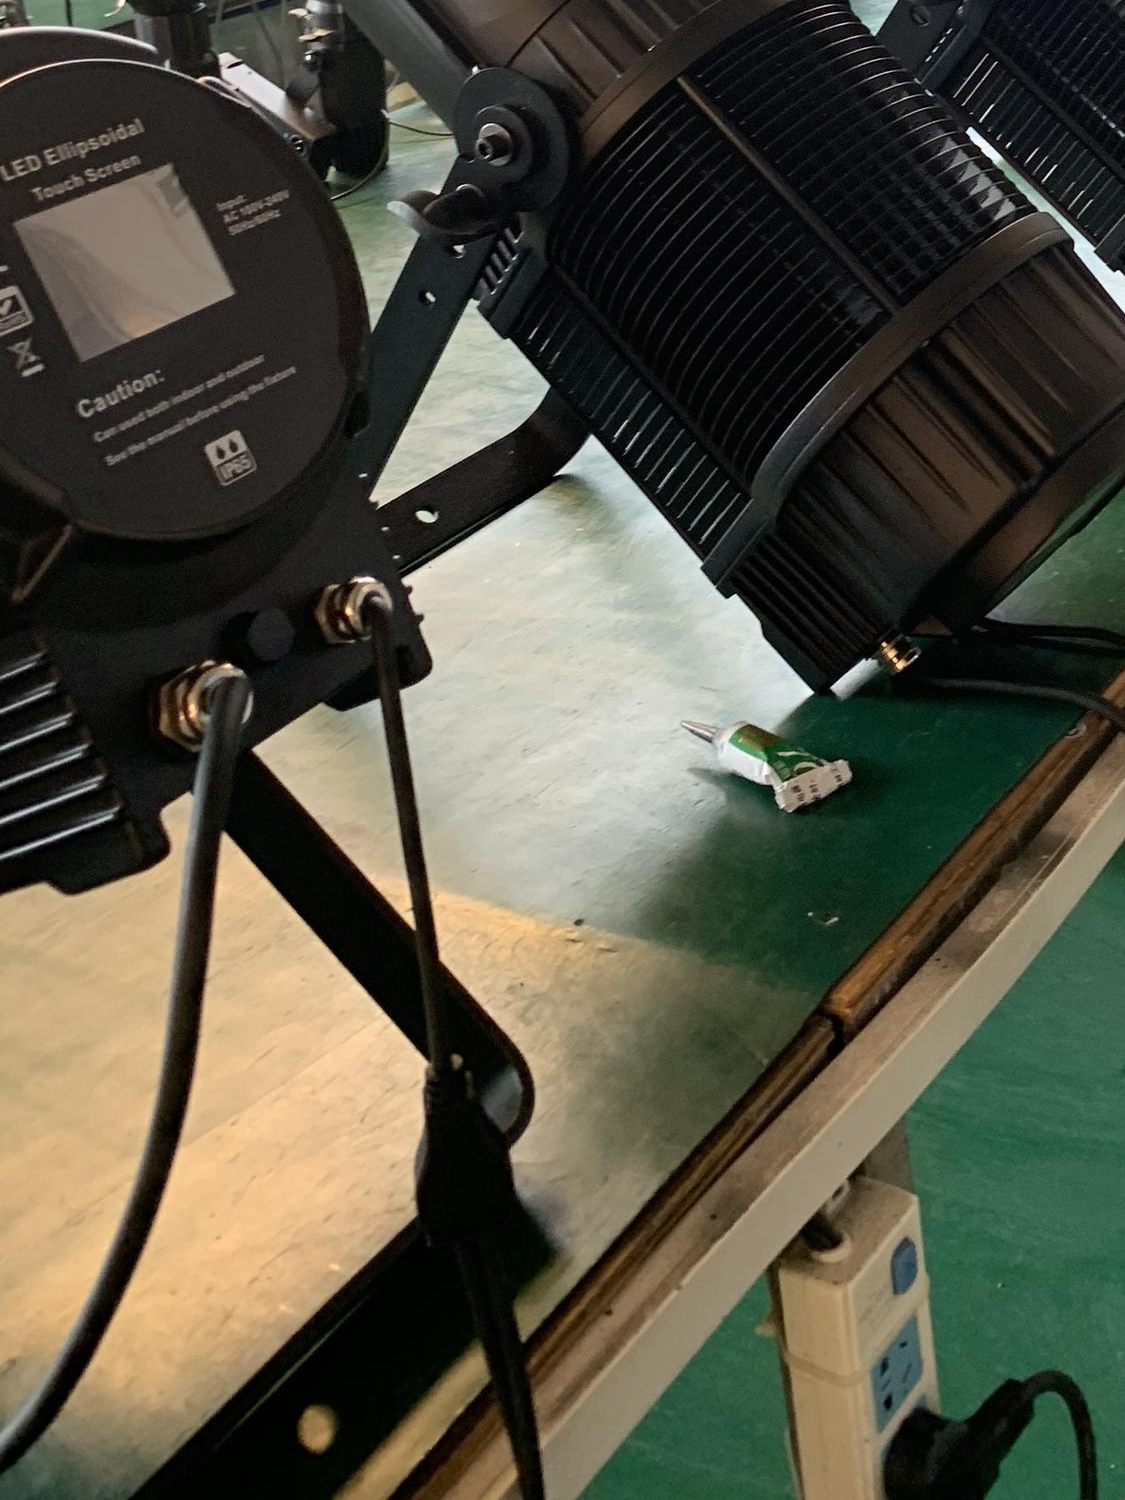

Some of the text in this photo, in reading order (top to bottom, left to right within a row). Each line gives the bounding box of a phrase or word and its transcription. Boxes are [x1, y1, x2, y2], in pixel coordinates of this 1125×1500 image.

[0, 118, 145, 181] LED Ellipsoidal
[31, 155, 141, 200] Touch Screen
[77, 369, 165, 417] Caution:
